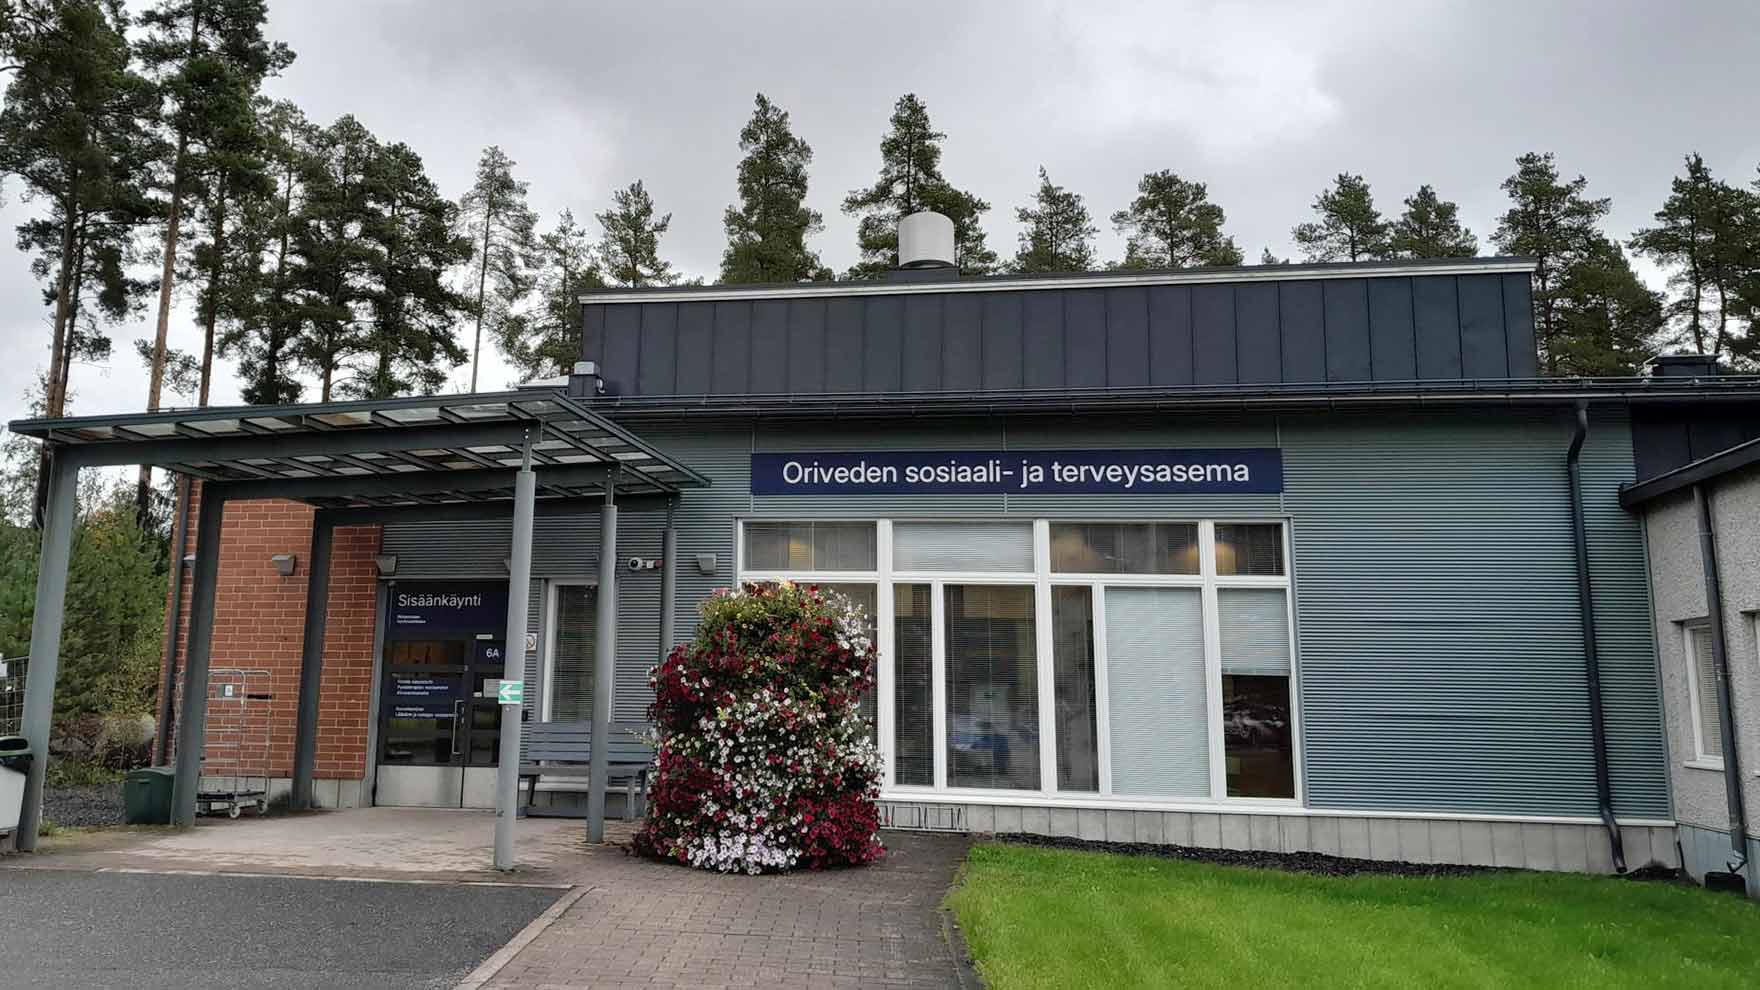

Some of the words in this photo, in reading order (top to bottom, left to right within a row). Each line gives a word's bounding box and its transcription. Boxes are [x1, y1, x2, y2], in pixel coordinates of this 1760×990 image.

[782, 460, 897, 484] Oriveden
[905, 459, 1014, 484] sosiaali-
[1020, 459, 1045, 489] ja
[1051, 461, 1250, 488] terveysasema
[398, 593, 481, 609] Sisäänkäynti
[486, 648, 499, 658] 6A
